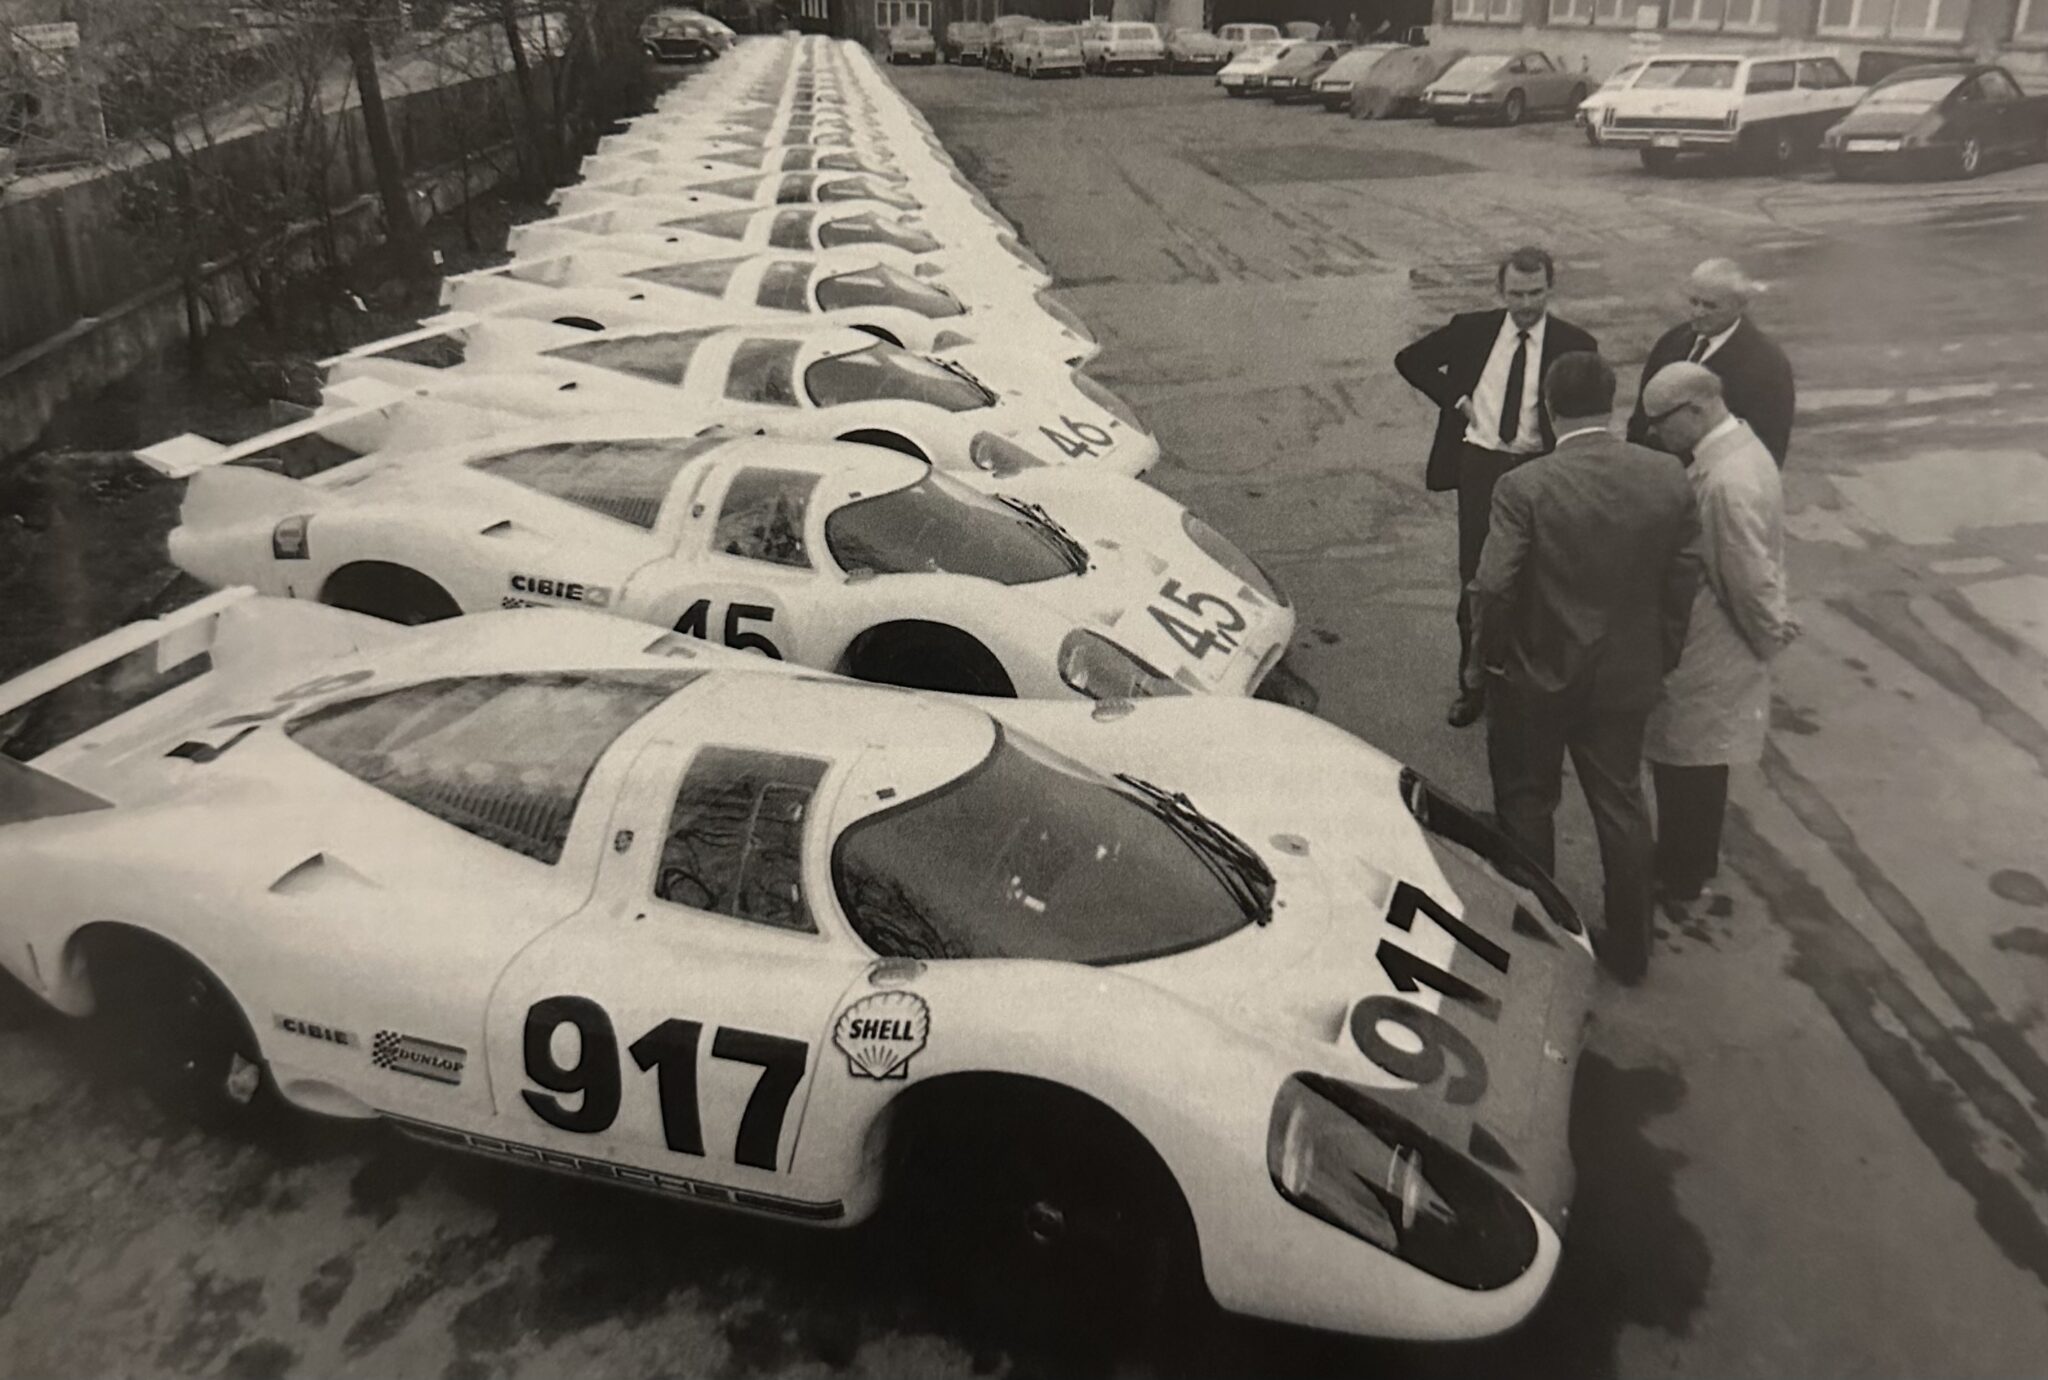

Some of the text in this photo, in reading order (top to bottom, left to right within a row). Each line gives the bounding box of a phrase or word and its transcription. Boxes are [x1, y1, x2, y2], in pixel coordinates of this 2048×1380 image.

[1038, 415, 1114, 458] 46
[511, 574, 583, 601] CIBIE
[1146, 578, 1247, 660] 45
[1351, 880, 1511, 1106] 917
[283, 1018, 349, 1046] CIBIE
[849, 1018, 914, 1041] SHELL
[400, 1048, 464, 1073] DUNLOP
[521, 995, 809, 1171] 917
